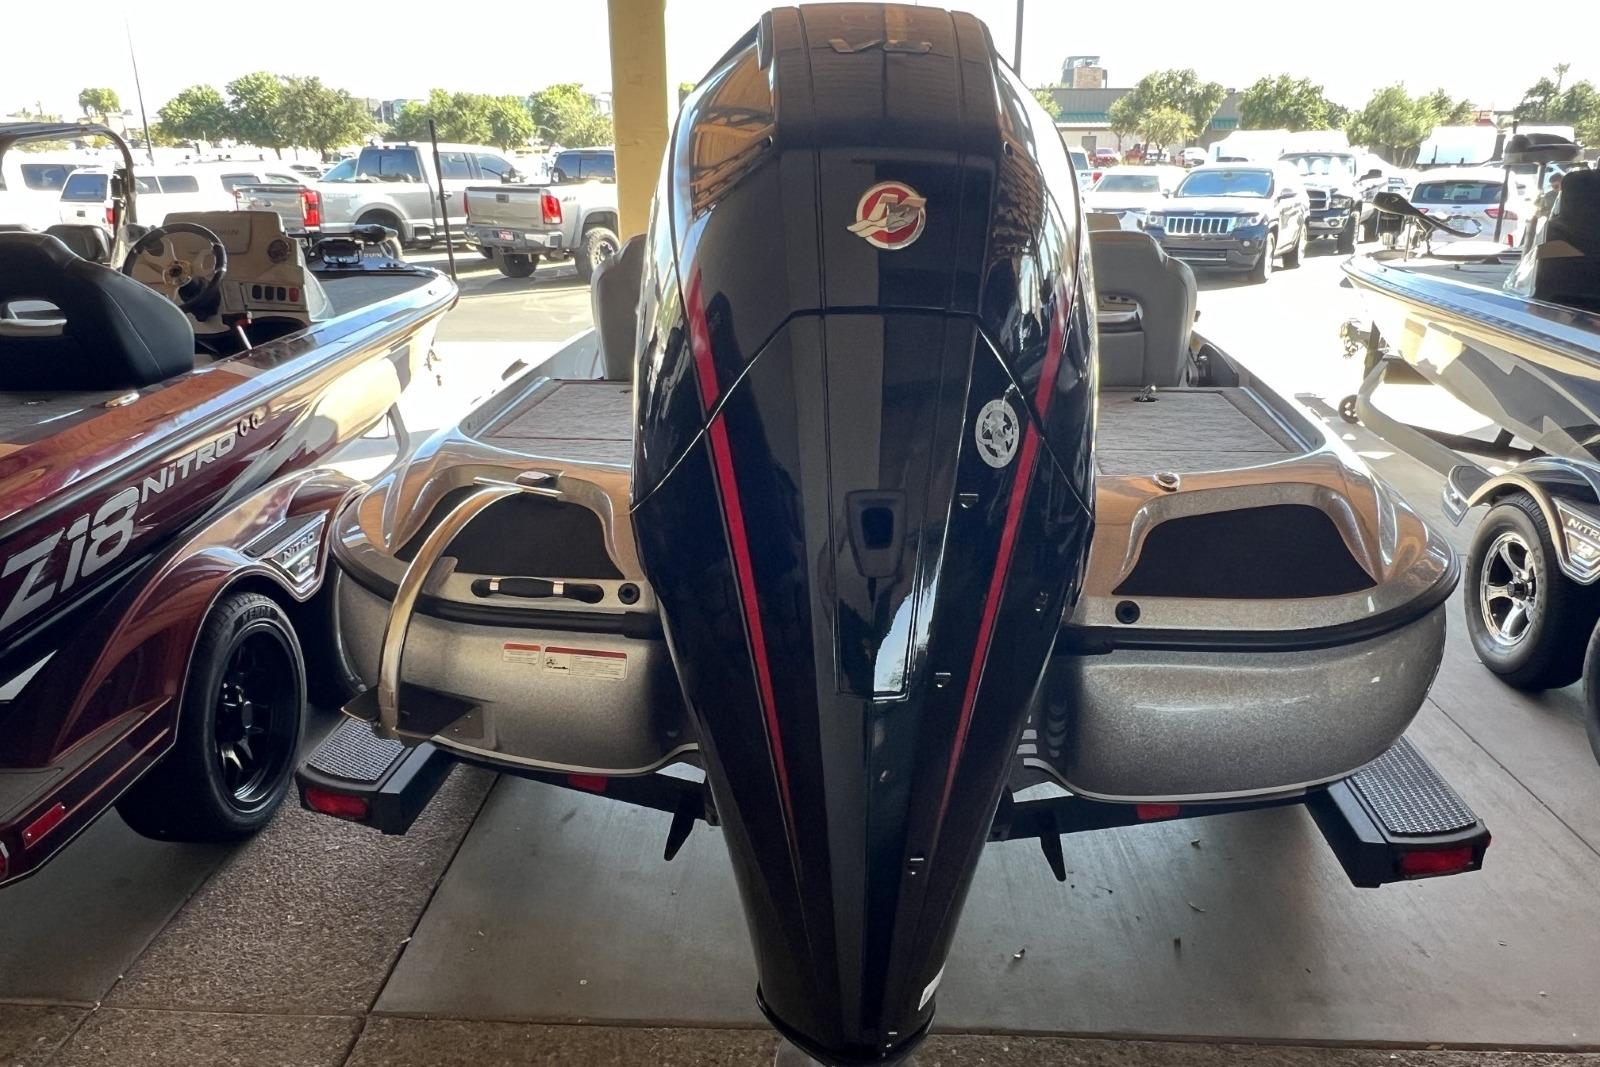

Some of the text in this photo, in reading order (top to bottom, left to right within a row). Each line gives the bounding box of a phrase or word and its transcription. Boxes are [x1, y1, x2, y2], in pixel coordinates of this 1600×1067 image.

[0, 432, 236, 629] Z18 NITRO
[282, 532, 315, 562] NITRO
